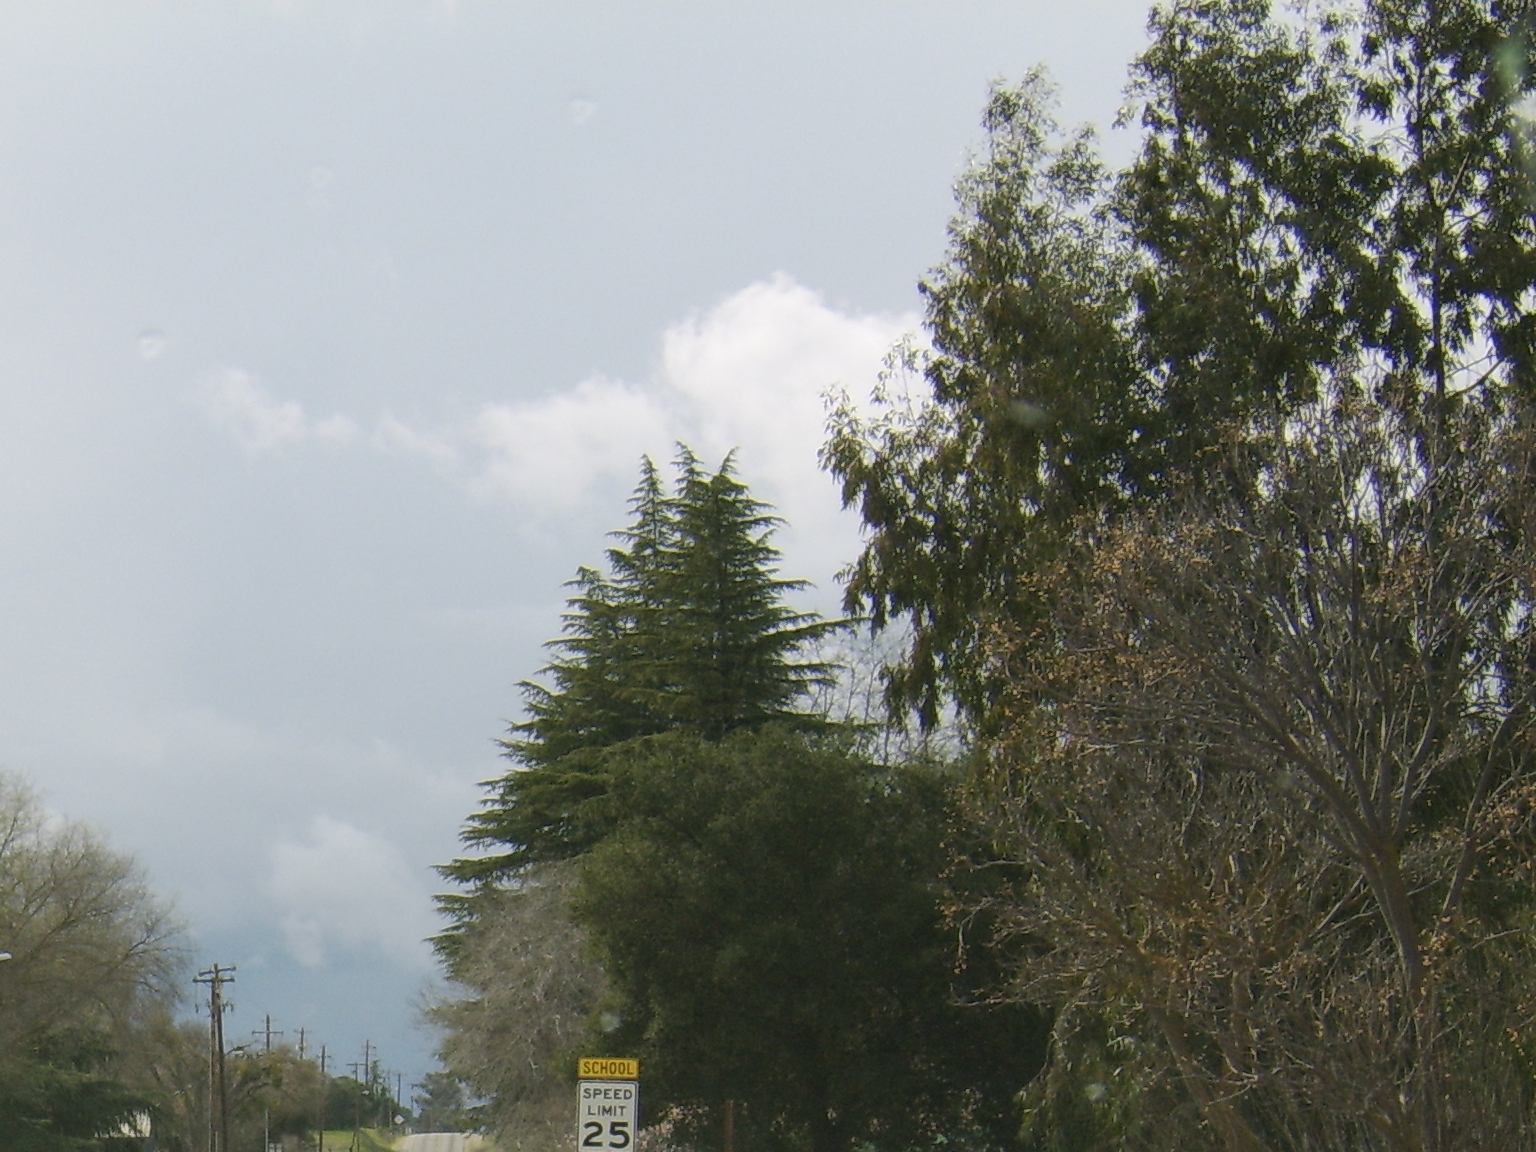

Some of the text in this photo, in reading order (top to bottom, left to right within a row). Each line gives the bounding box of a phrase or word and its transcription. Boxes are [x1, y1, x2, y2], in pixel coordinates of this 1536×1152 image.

[583, 1061, 634, 1075] SCHOOL
[583, 1087, 633, 1100] SPEED
[587, 1104, 627, 1117] LIMIT
[582, 1121, 630, 1149] 25
